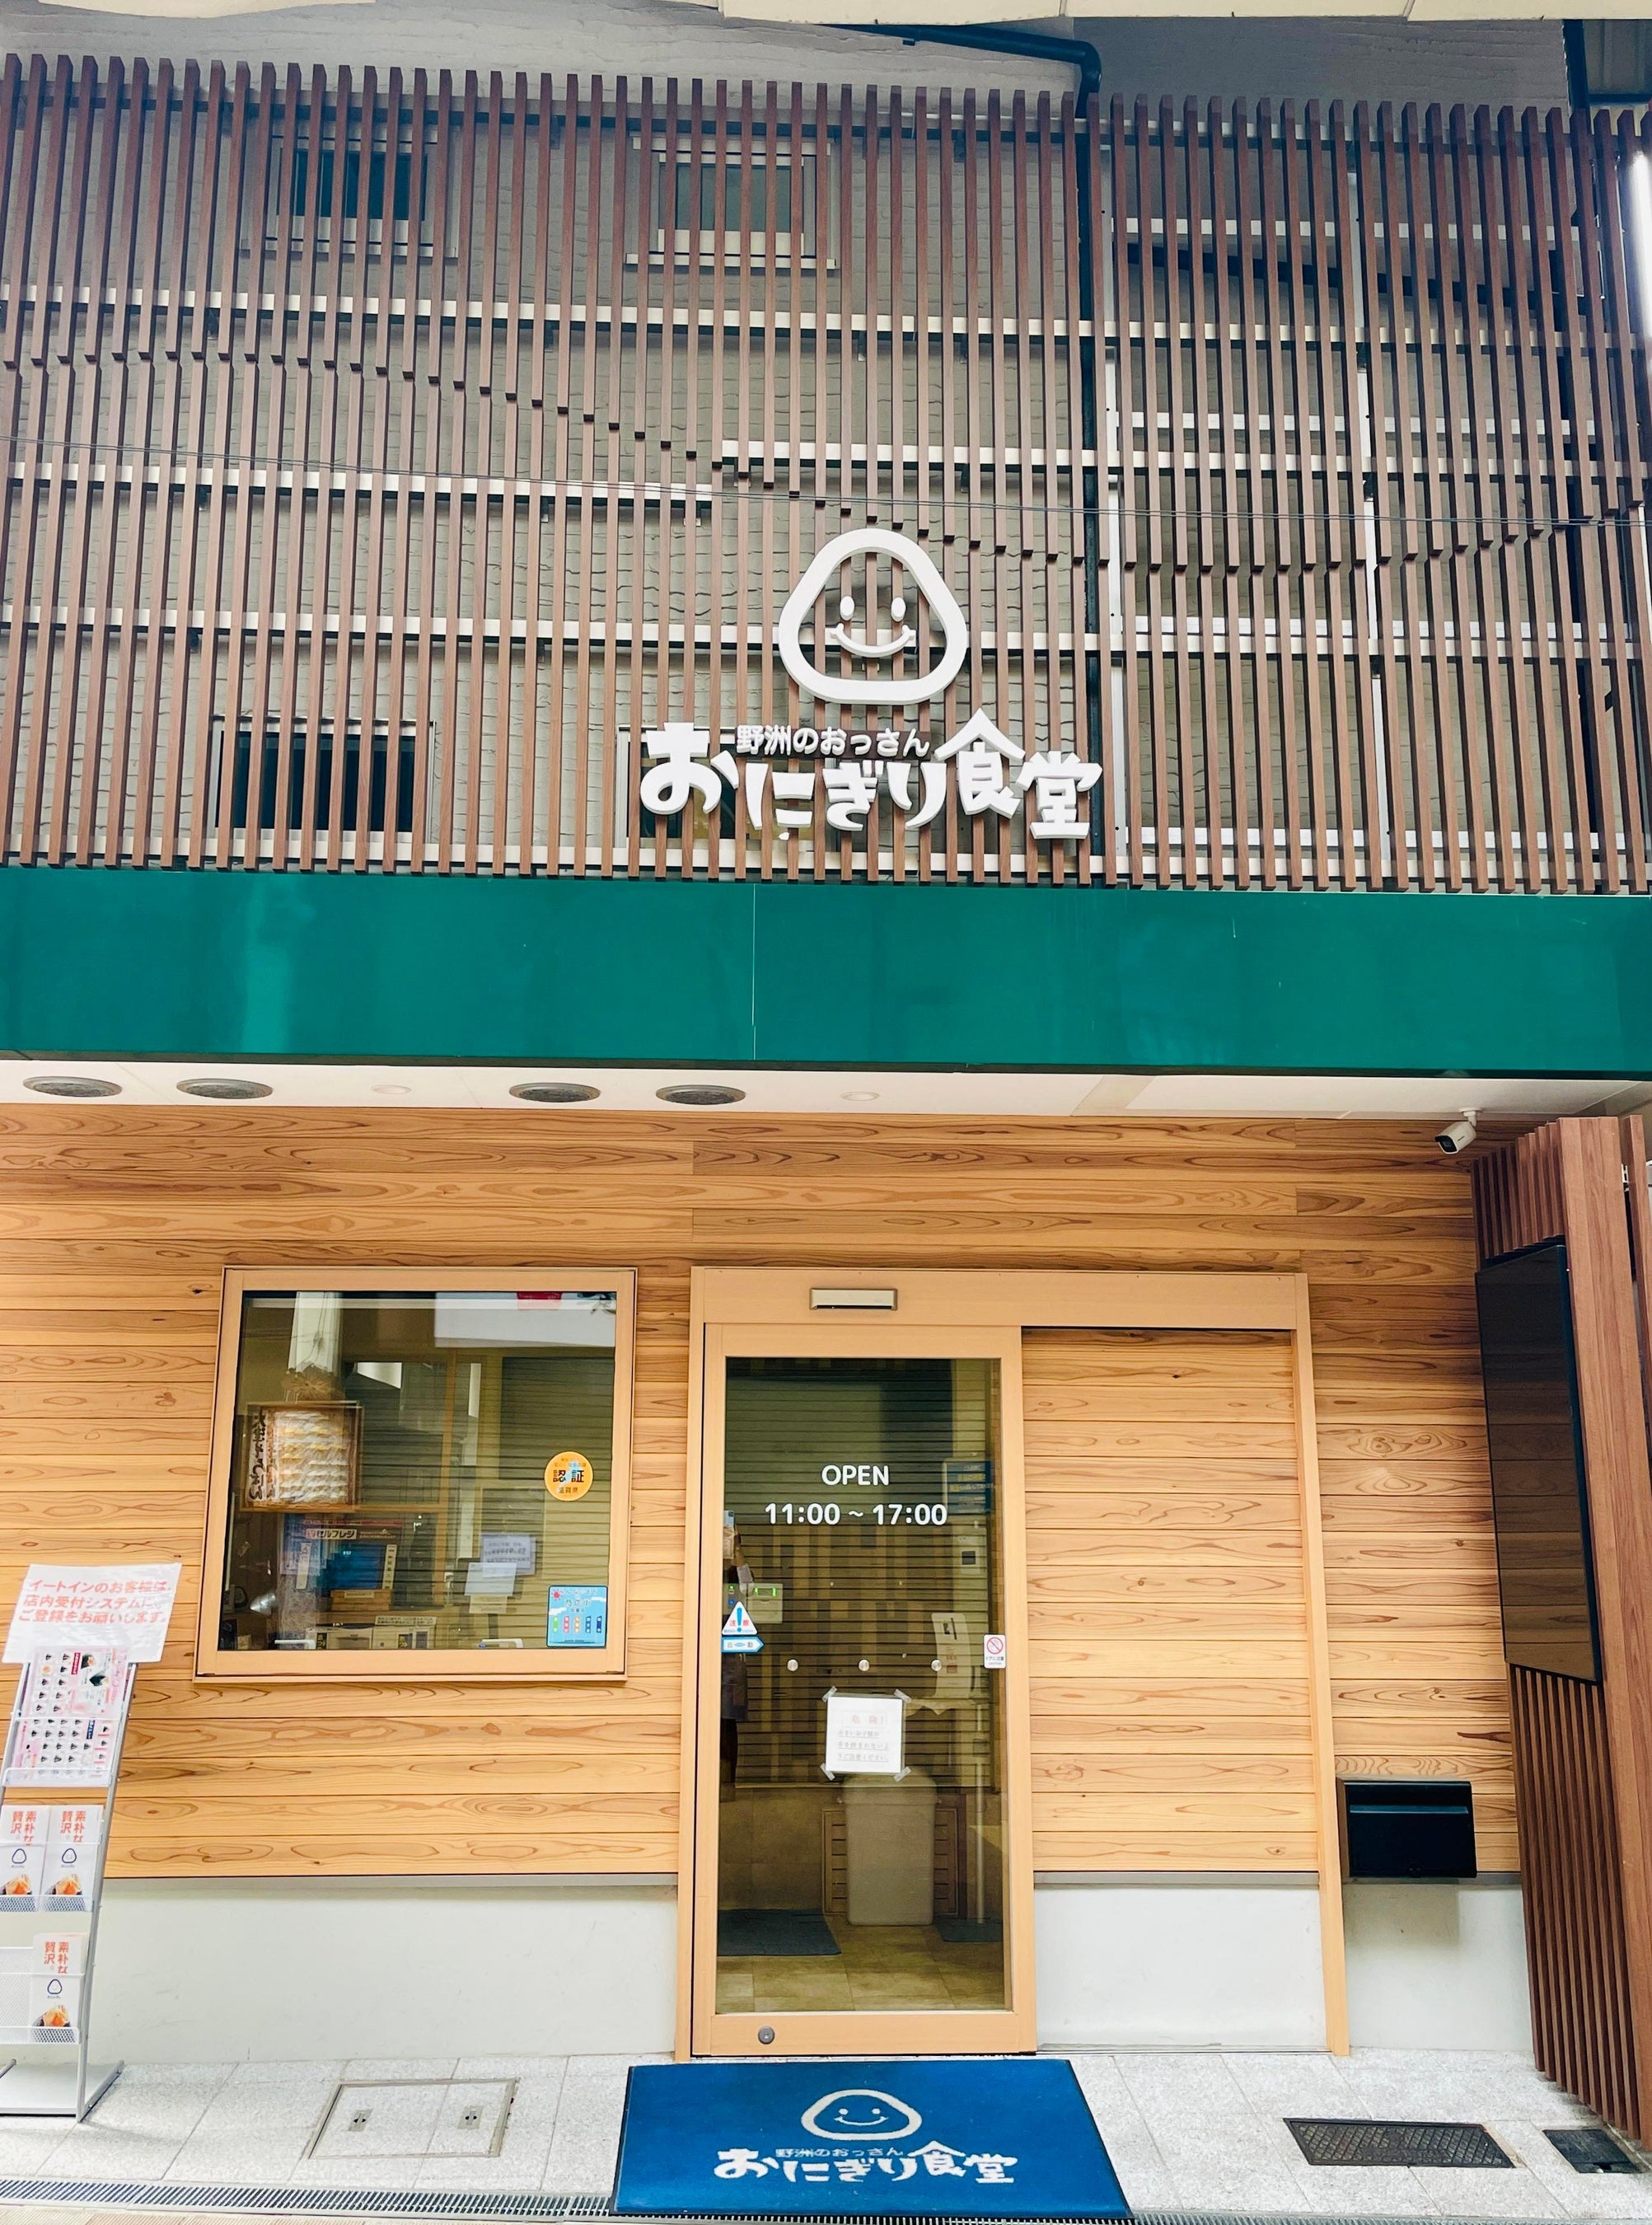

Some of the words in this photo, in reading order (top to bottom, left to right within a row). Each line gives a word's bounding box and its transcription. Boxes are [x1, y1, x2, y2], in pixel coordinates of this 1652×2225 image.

[737, 725, 930, 757] 野洲のおっさん
[640, 708, 1102, 840] おにぎり食堂
[553, 1469, 584, 1483] 認証
[821, 1464, 890, 1486] OPEN
[765, 1502, 840, 1525] 11:00
[873, 1503, 948, 1525] 17:00
[317, 1529, 355, 1539] セルフレジ
[714, 2140, 1018, 2185] おにぎり食堂
[775, 2148, 904, 2159] 野洲のおっさん
